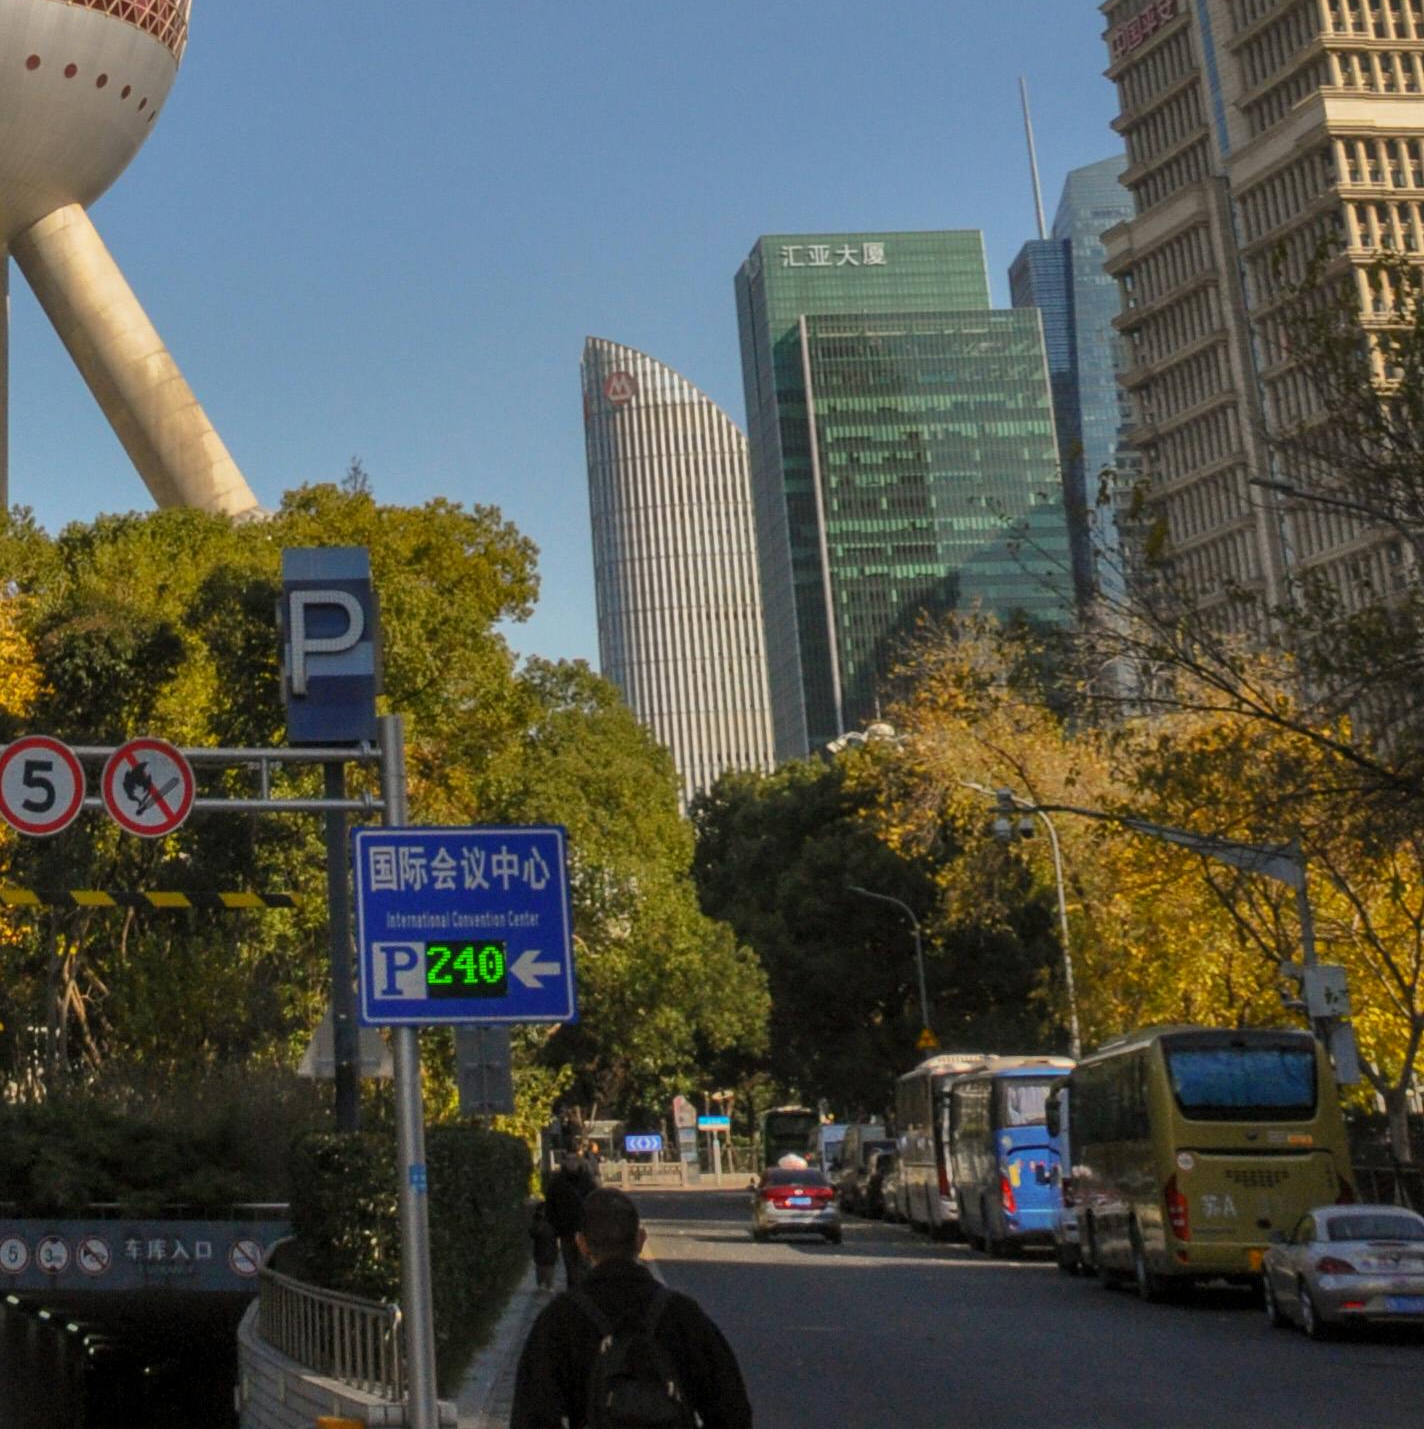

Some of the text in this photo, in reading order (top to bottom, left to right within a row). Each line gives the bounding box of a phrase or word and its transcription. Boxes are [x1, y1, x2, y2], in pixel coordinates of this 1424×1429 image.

[779, 242, 887, 267] 汇亚大厦
[289, 590, 365, 695] P
[22, 760, 56, 814] 5
[369, 845, 551, 890] 国际会议中心
[387, 910, 540, 929] International Convention Center
[379, 946, 419, 996] P
[427, 946, 504, 984] 240
[126, 1239, 212, 1259] 车库入口
